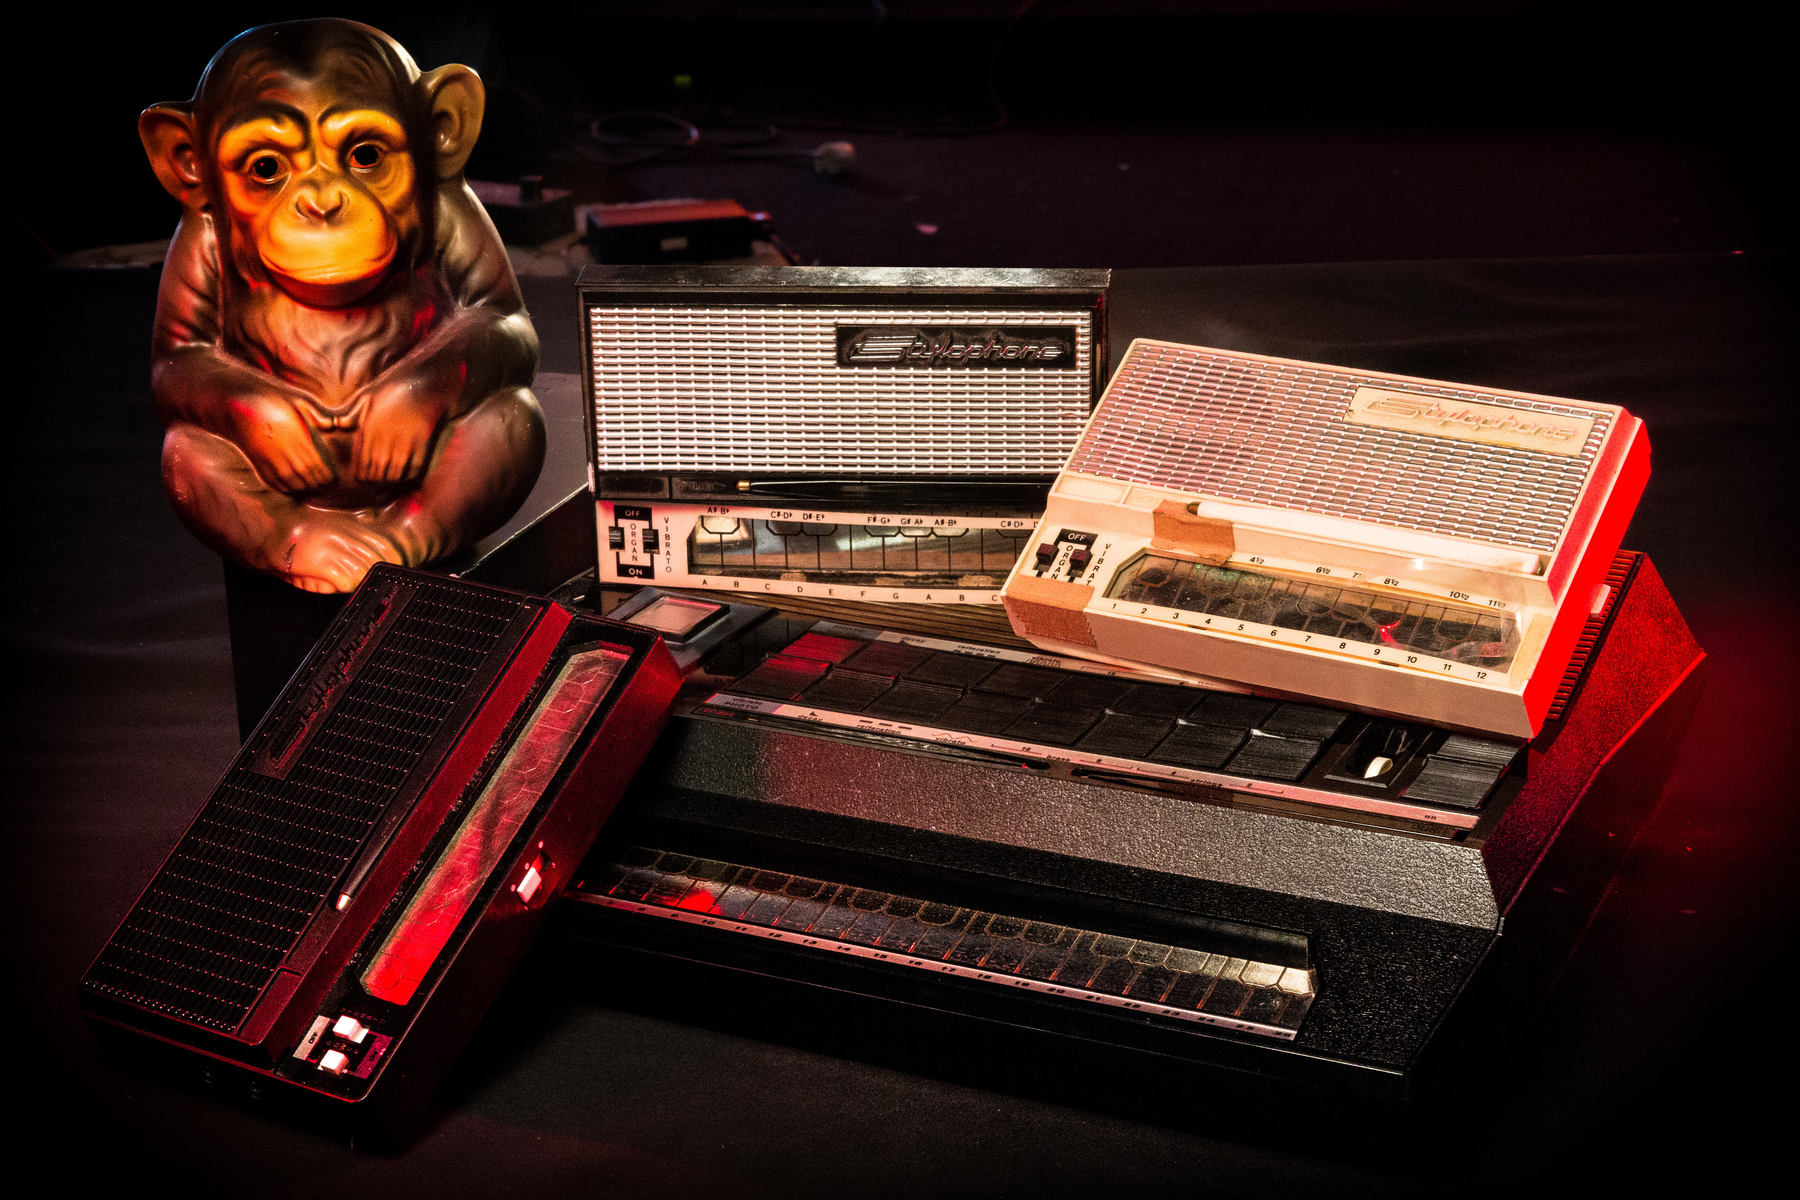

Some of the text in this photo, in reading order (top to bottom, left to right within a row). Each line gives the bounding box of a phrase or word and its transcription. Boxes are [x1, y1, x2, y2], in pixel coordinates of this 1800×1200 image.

[848, 334, 1065, 366] Stylophone
[1365, 397, 1577, 440] Stylophone
[629, 523, 639, 562] ORGAN
[663, 517, 673, 574] VIBRATO
[1067, 532, 1087, 541] OFF
[628, 568, 644, 576] ON
[1051, 545, 1073, 580] ORGAN
[1086, 543, 1112, 587] VIBRAT
[829, 588, 834, 596] E
[861, 590, 866, 598] F
[893, 592, 899, 600] G
[1373, 648, 1381, 656] 9
[1406, 655, 1418, 664] 10
[1443, 663, 1452, 671] 11
[1477, 671, 1487, 679] 12
